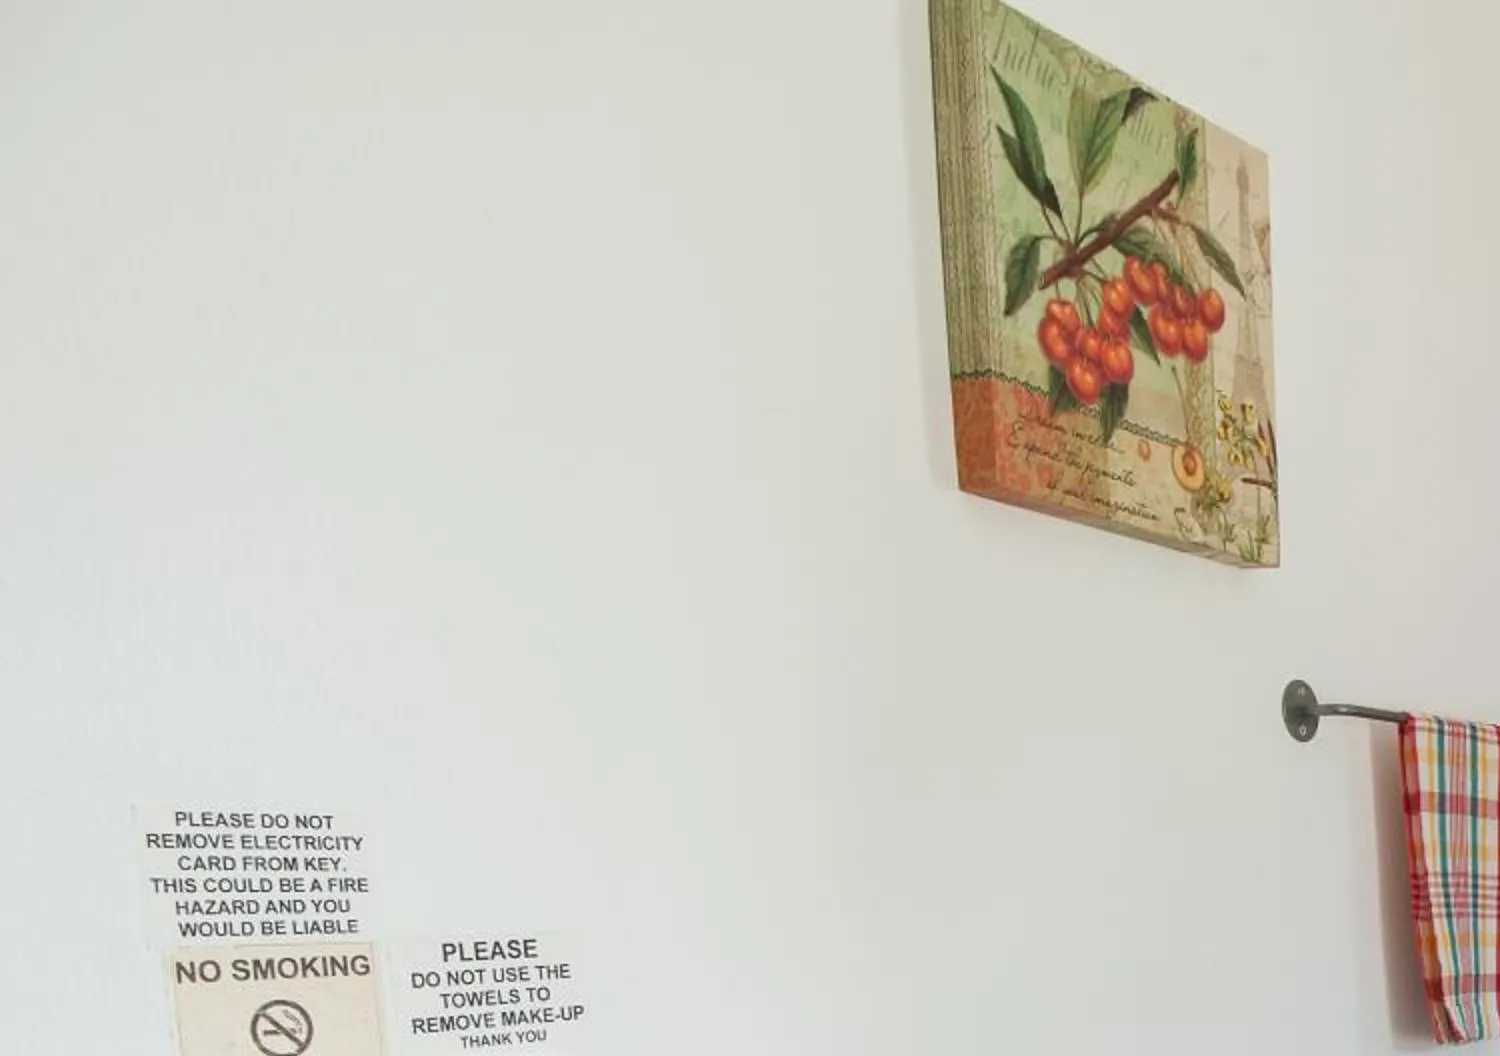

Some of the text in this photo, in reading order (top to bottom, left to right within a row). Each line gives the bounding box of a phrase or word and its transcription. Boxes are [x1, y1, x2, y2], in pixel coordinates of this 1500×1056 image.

[175, 811, 334, 829] PLEASE DO NOT
[146, 833, 364, 851] REMOVE ELECTRICITY
[177, 855, 347, 872] CARD FROM KEY.
[150, 877, 369, 893] THIS COULD BE A FIRE
[175, 899, 350, 915] HAZARD AND YOU
[178, 919, 359, 937] WOULD BE LIABLE
[442, 939, 539, 962] PLEASE
[175, 955, 371, 984] NO SMOKING
[411, 963, 571, 988] DO NOT USE THE
[440, 987, 551, 1009] TOWELS TO
[412, 1005, 585, 1034] REMOVE MAKE-UP
[460, 1029, 547, 1049] THANK YOU
